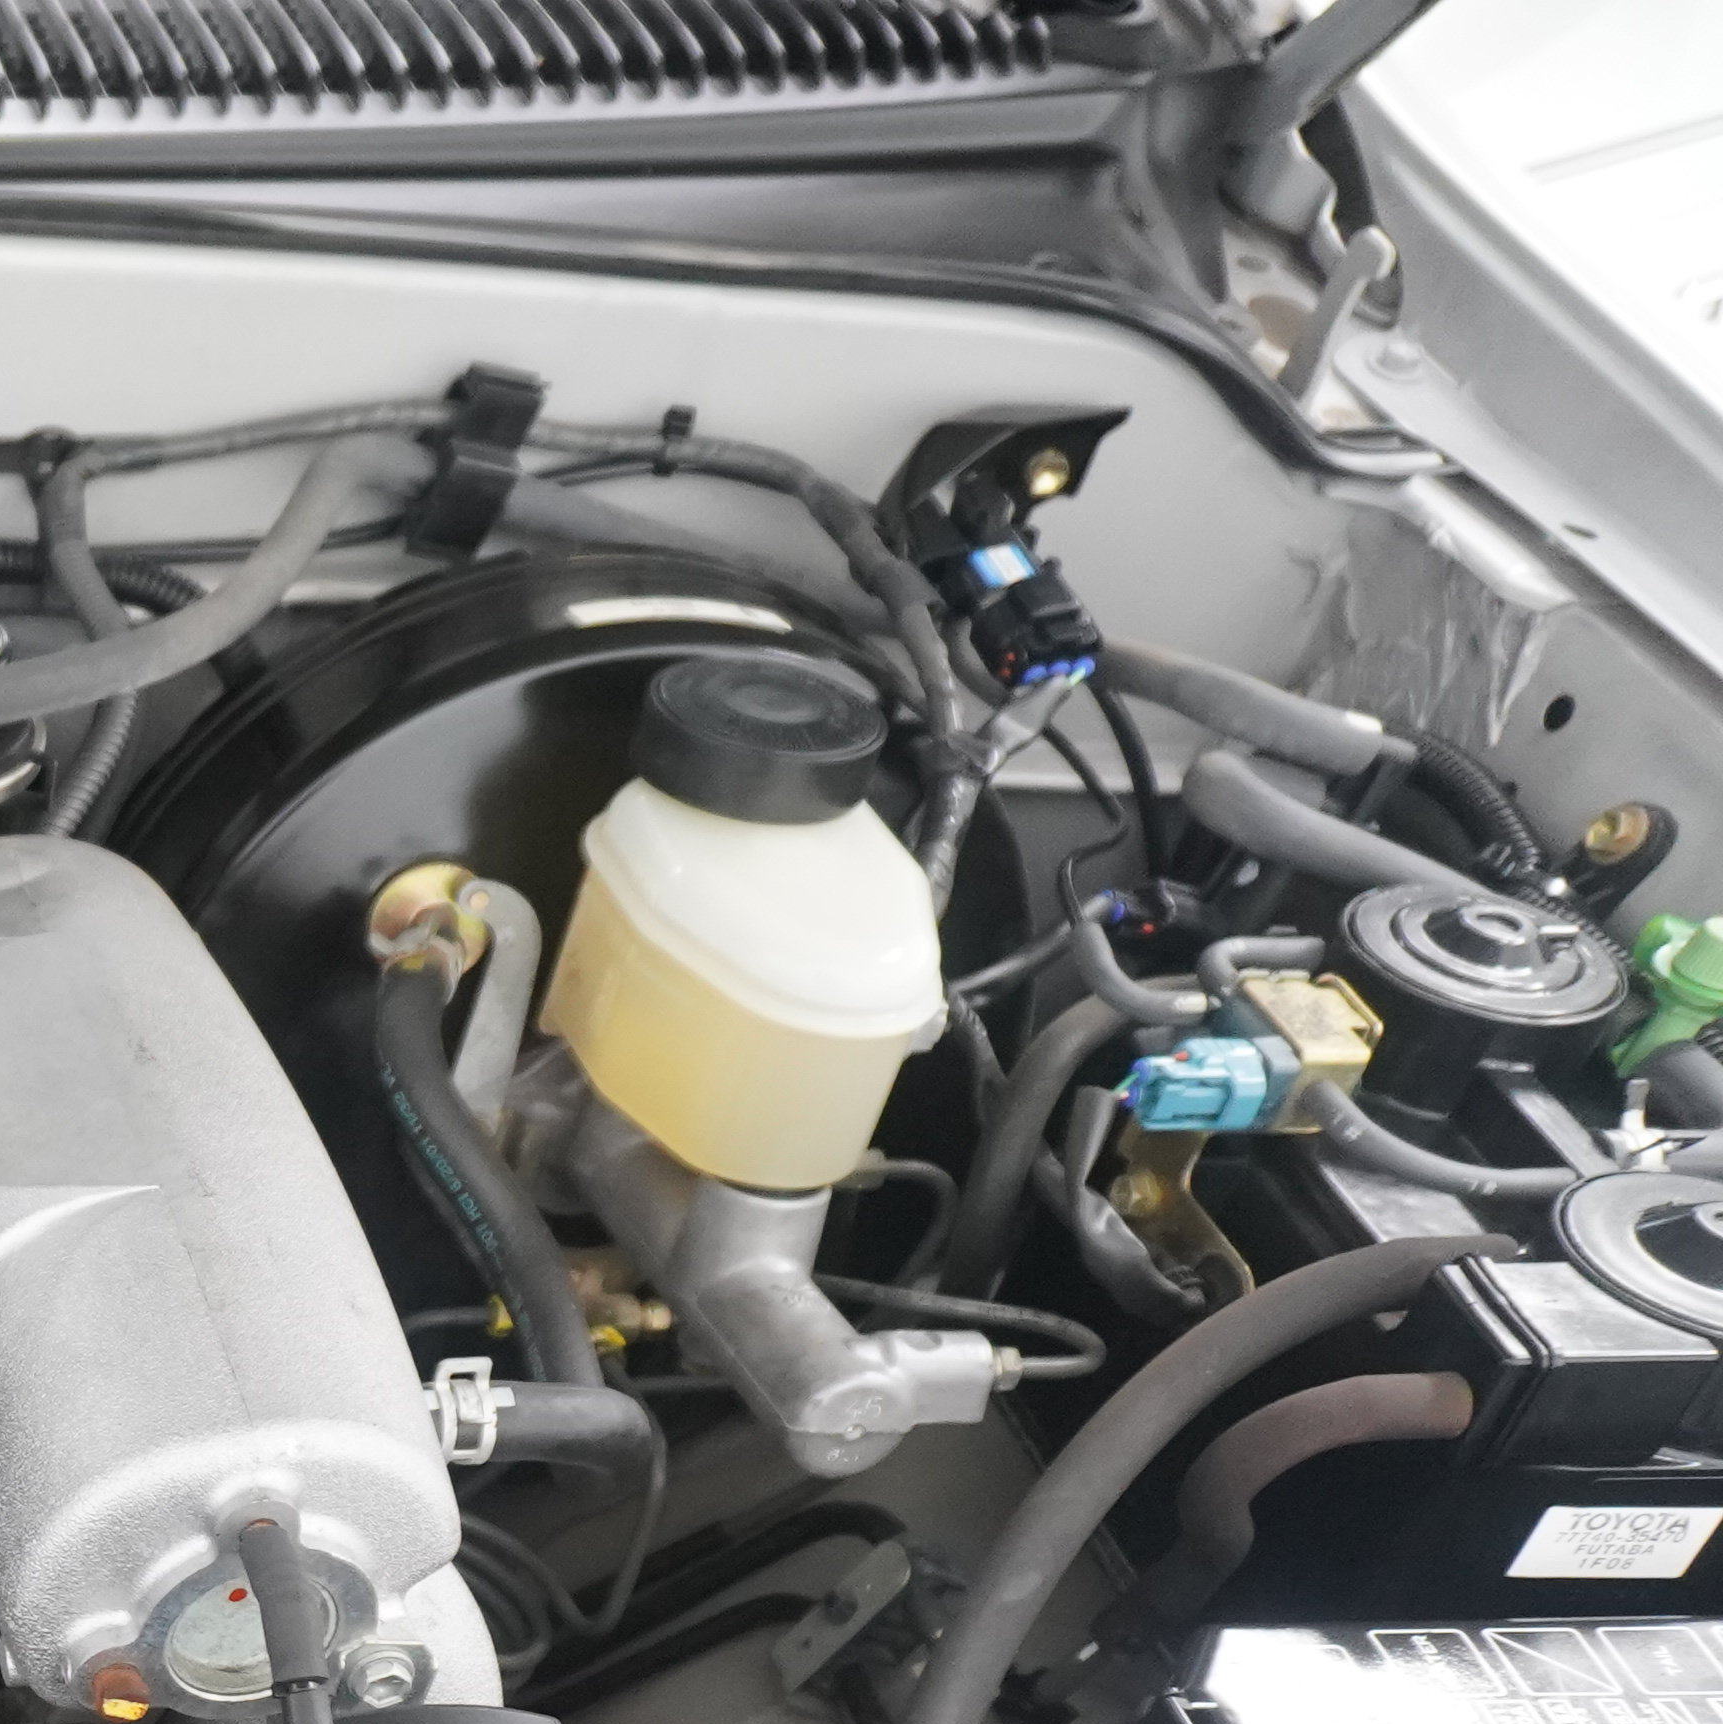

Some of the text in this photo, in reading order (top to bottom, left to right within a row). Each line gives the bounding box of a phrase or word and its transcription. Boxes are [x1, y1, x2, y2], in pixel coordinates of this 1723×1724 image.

[1569, 1512, 1691, 1532] TOYOTA
[1555, 1530, 1688, 1543] 77740-35470
[1574, 1544, 1655, 1555] FUTABA
